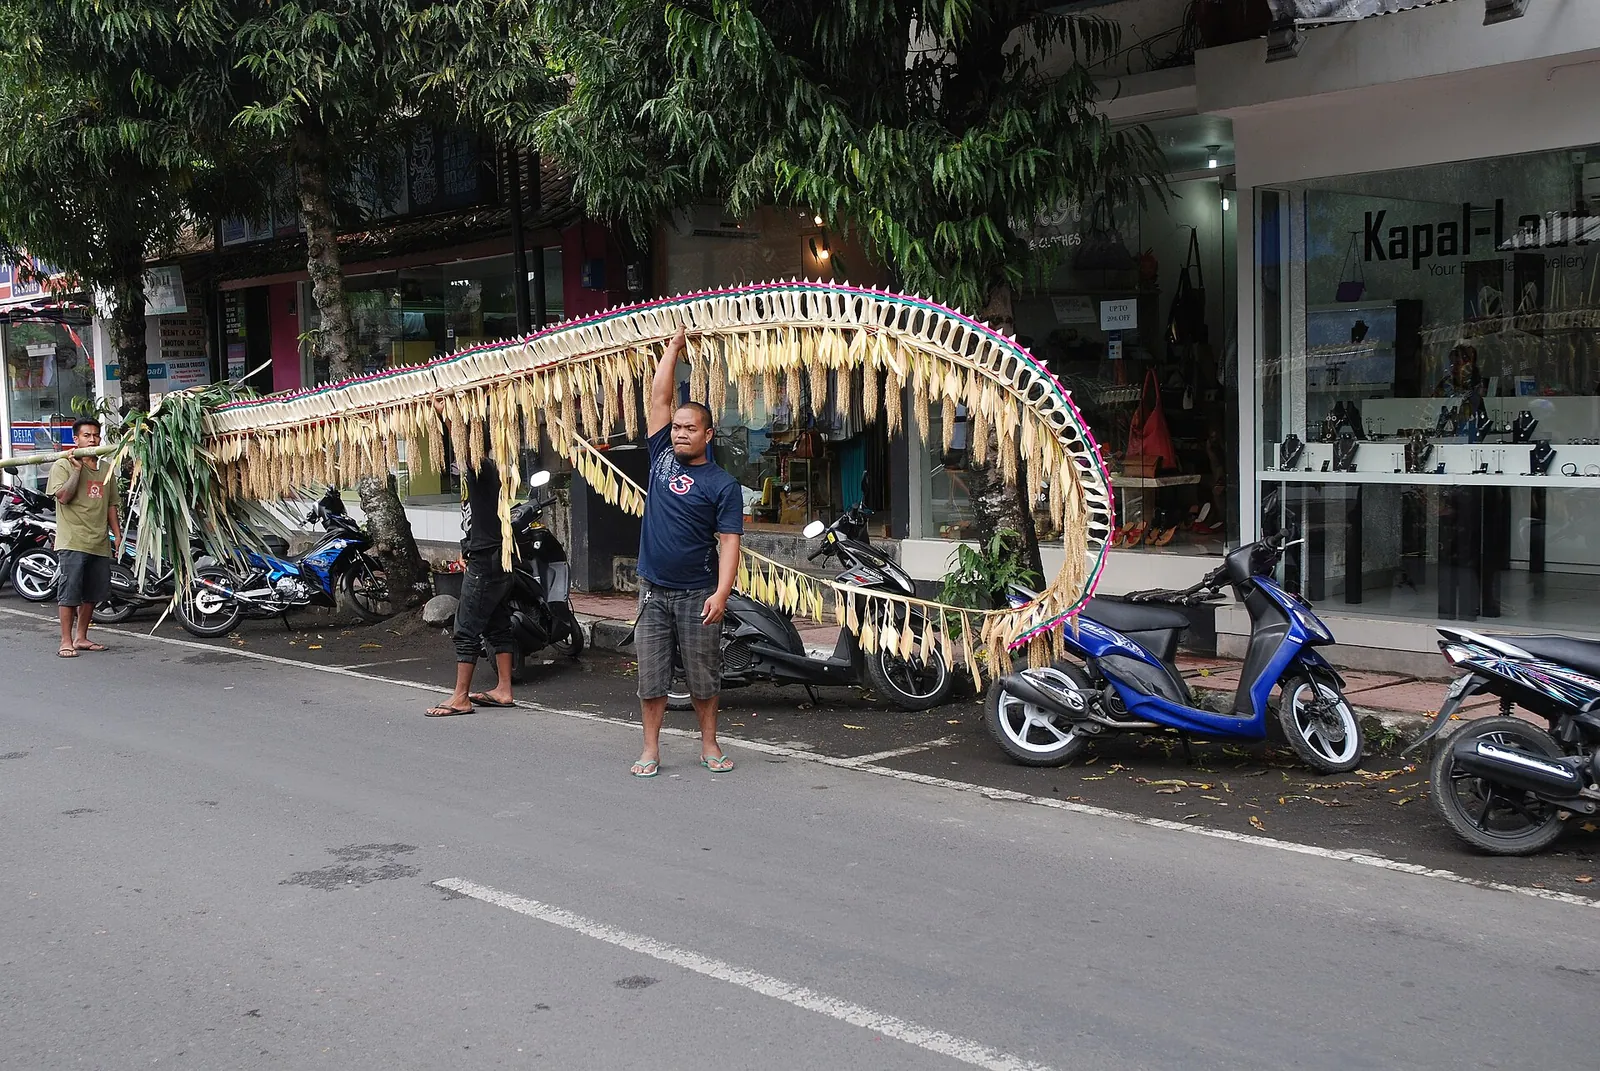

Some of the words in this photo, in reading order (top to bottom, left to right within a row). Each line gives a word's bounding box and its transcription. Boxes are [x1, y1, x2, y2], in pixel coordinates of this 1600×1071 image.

[1428, 263, 1457, 276] Your
[1118, 304, 1128, 312] TO
[164, 339, 185, 347] MOTOR
[13, 429, 32, 438] DELTA
[862, 567, 884, 581] HONDA
